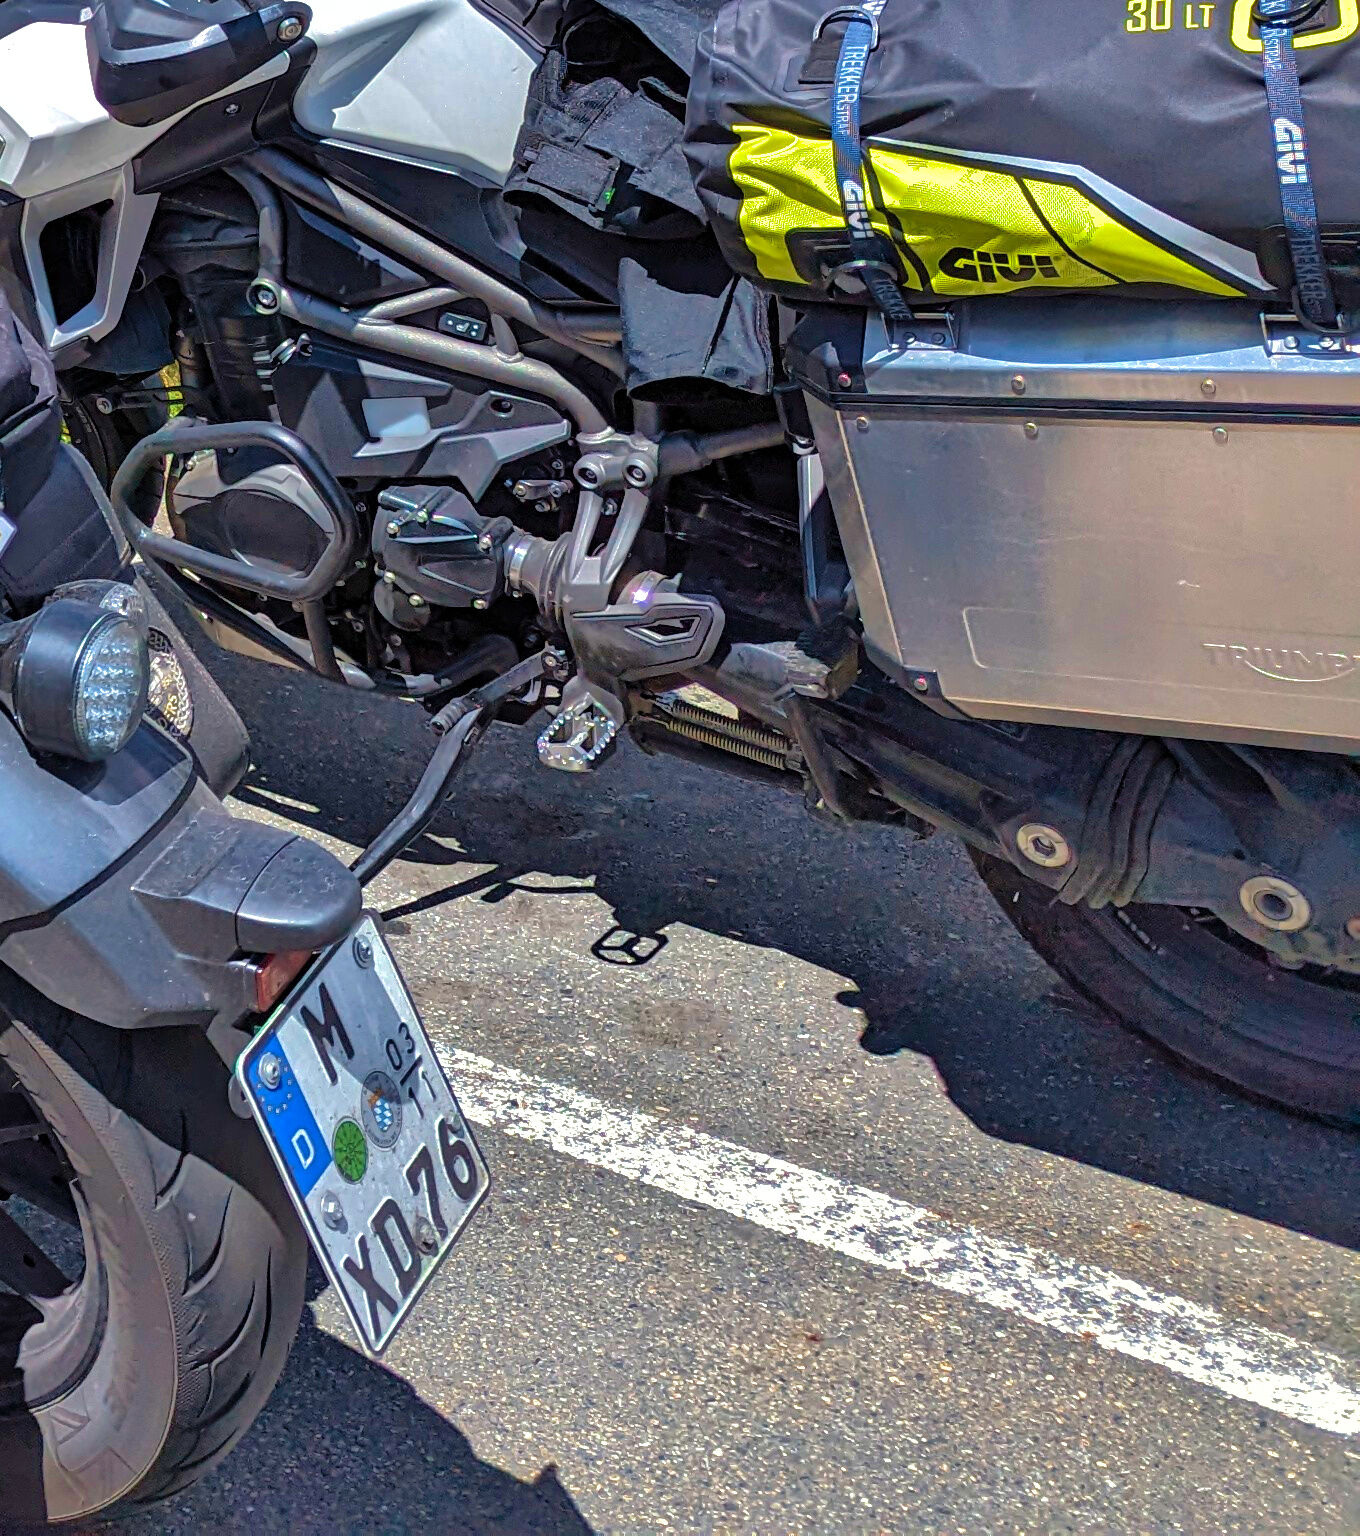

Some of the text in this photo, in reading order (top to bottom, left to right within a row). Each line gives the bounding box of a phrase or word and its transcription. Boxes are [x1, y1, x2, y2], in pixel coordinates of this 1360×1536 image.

[1185, 2, 1216, 30] LT
[1273, 118, 1308, 185] GIVI
[843, 180, 873, 239] GIVI
[938, 246, 1056, 284] GIVI
[300, 982, 355, 1086] M
[290, 1128, 315, 1169] D
